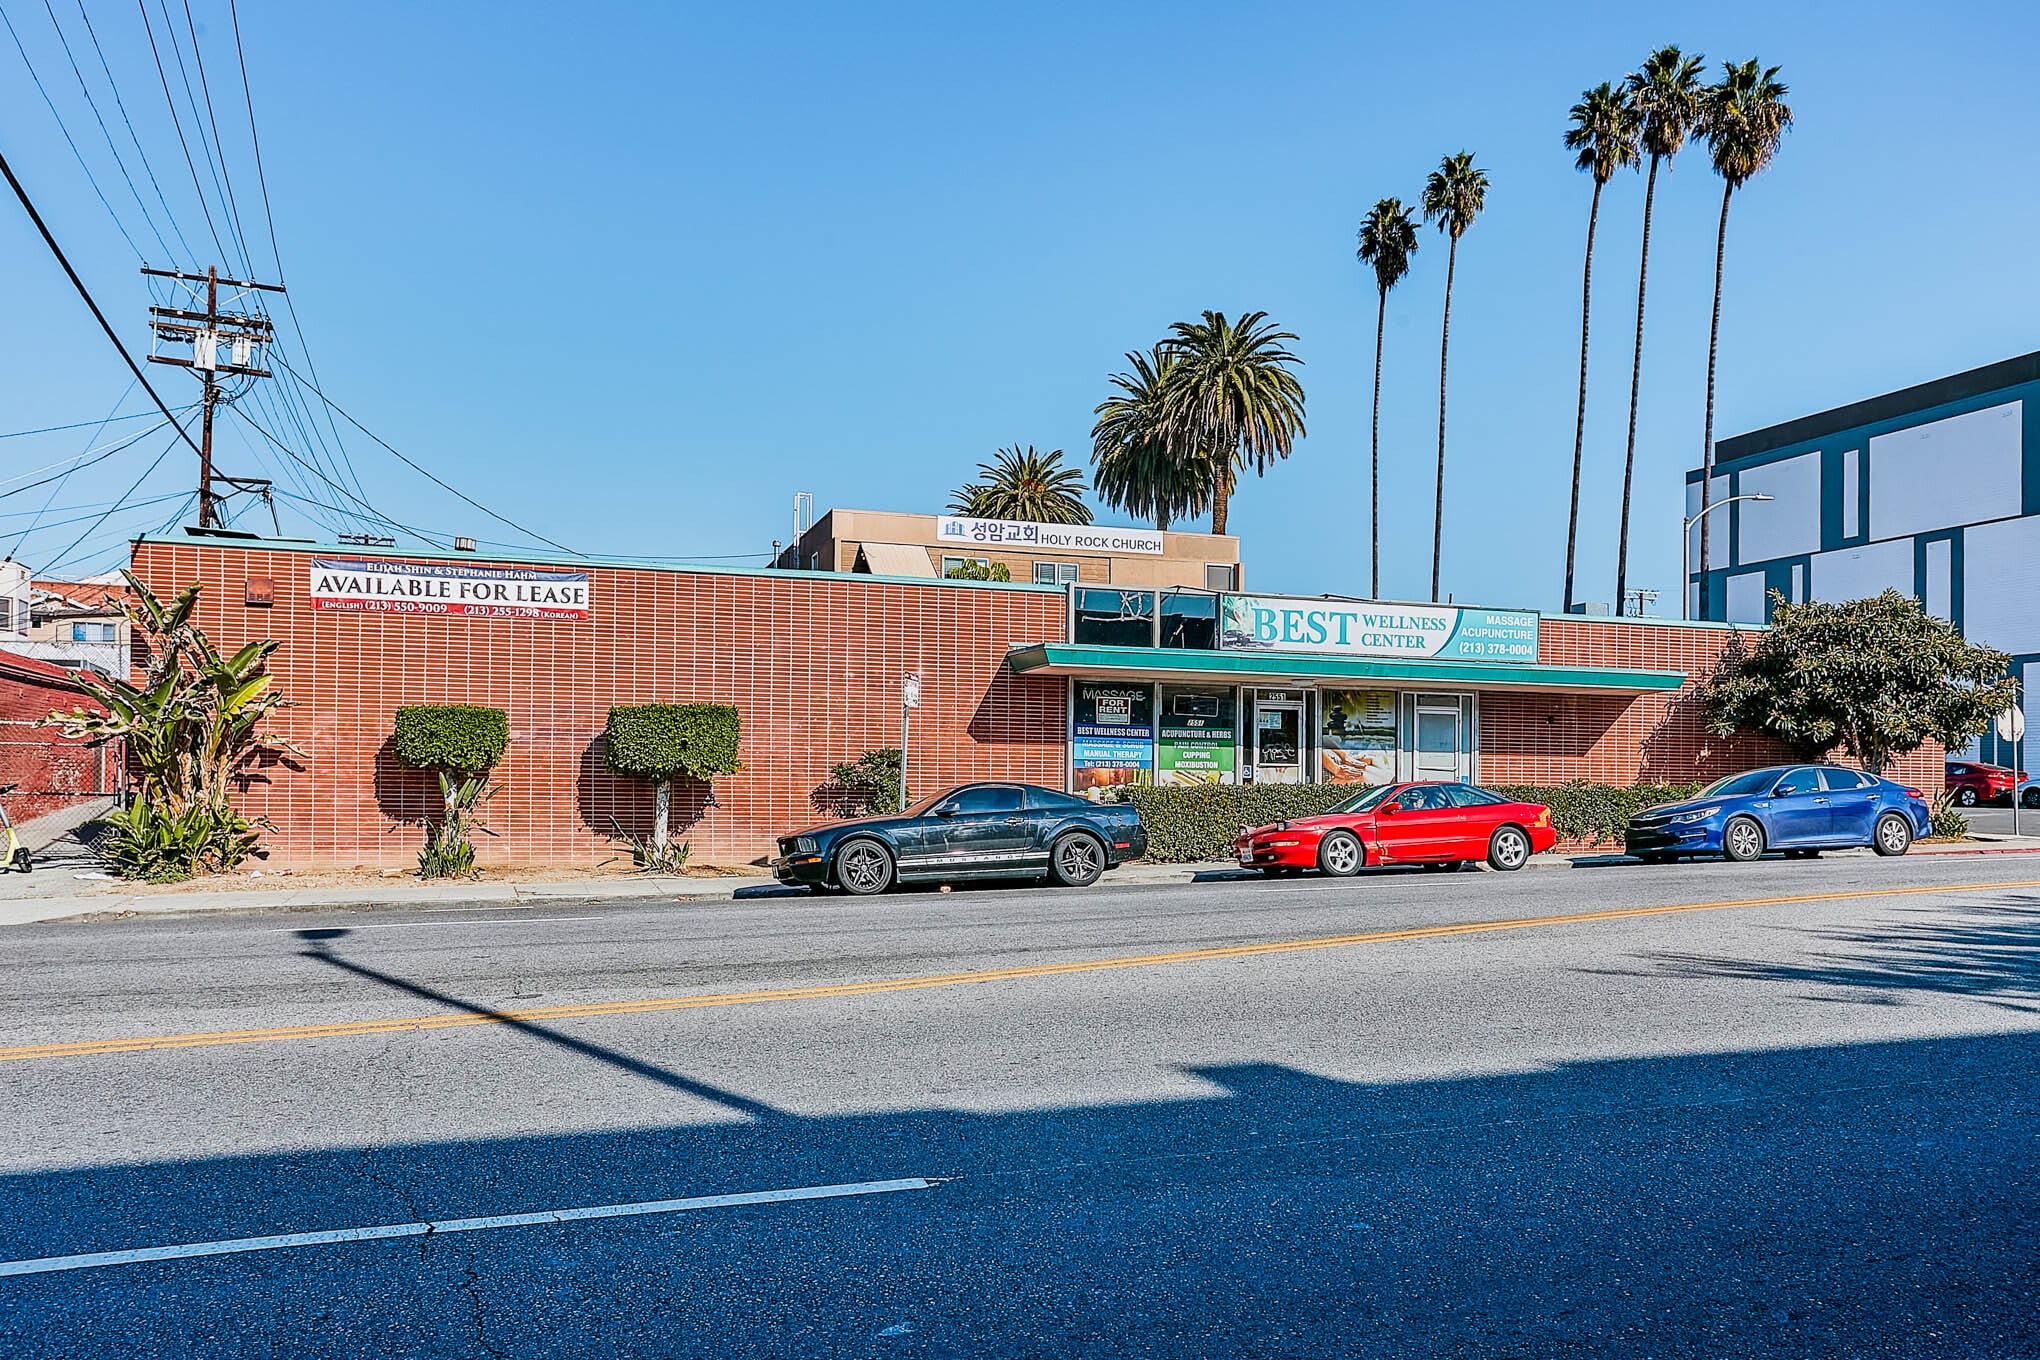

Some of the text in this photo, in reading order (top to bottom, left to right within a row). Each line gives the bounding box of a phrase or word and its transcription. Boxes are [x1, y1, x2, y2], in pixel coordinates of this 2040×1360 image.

[971, 521, 1039, 544] 성암교회
[1041, 534, 1161, 551] HOLY ROCK CHURCH
[405, 564, 432, 574] SHIN
[434, 566, 443, 575] &
[445, 567, 502, 577] STEPHANIE
[504, 570, 537, 580] HAHM
[317, 575, 585, 605] AVAILABLE FOR LEASE
[321, 601, 363, 610] (ENGLISH)
[365, 600, 391, 611] (213)
[464, 605, 490, 616] (213)
[492, 606, 540, 618] 255-1298
[540, 610, 579, 620] (KOREAN)
[1252, 607, 1357, 645] BEST
[1363, 614, 1447, 632] WELLNESS
[1486, 615, 1534, 627] MASSAGE
[1461, 627, 1533, 640] ACUPUNCTURE
[1361, 633, 1426, 649] CENTER
[1459, 641, 1533, 656] (213) 378-0004
[1099, 706, 1127, 714] RENT
[1077, 726, 1150, 737] BEST WELLNESS CENTER
[1161, 730, 1205, 738] ACUPUNCTURE
[1212, 731, 1232, 739] HERBS
[1082, 740, 1114, 748] MASSAGE
[1190, 742, 1220, 750] CONTROL
[1083, 749, 1143, 758] MANUAL THERAPY
[1182, 751, 1211, 759] CUPPING
[1174, 761, 1219, 769] MOXIBUSTION
